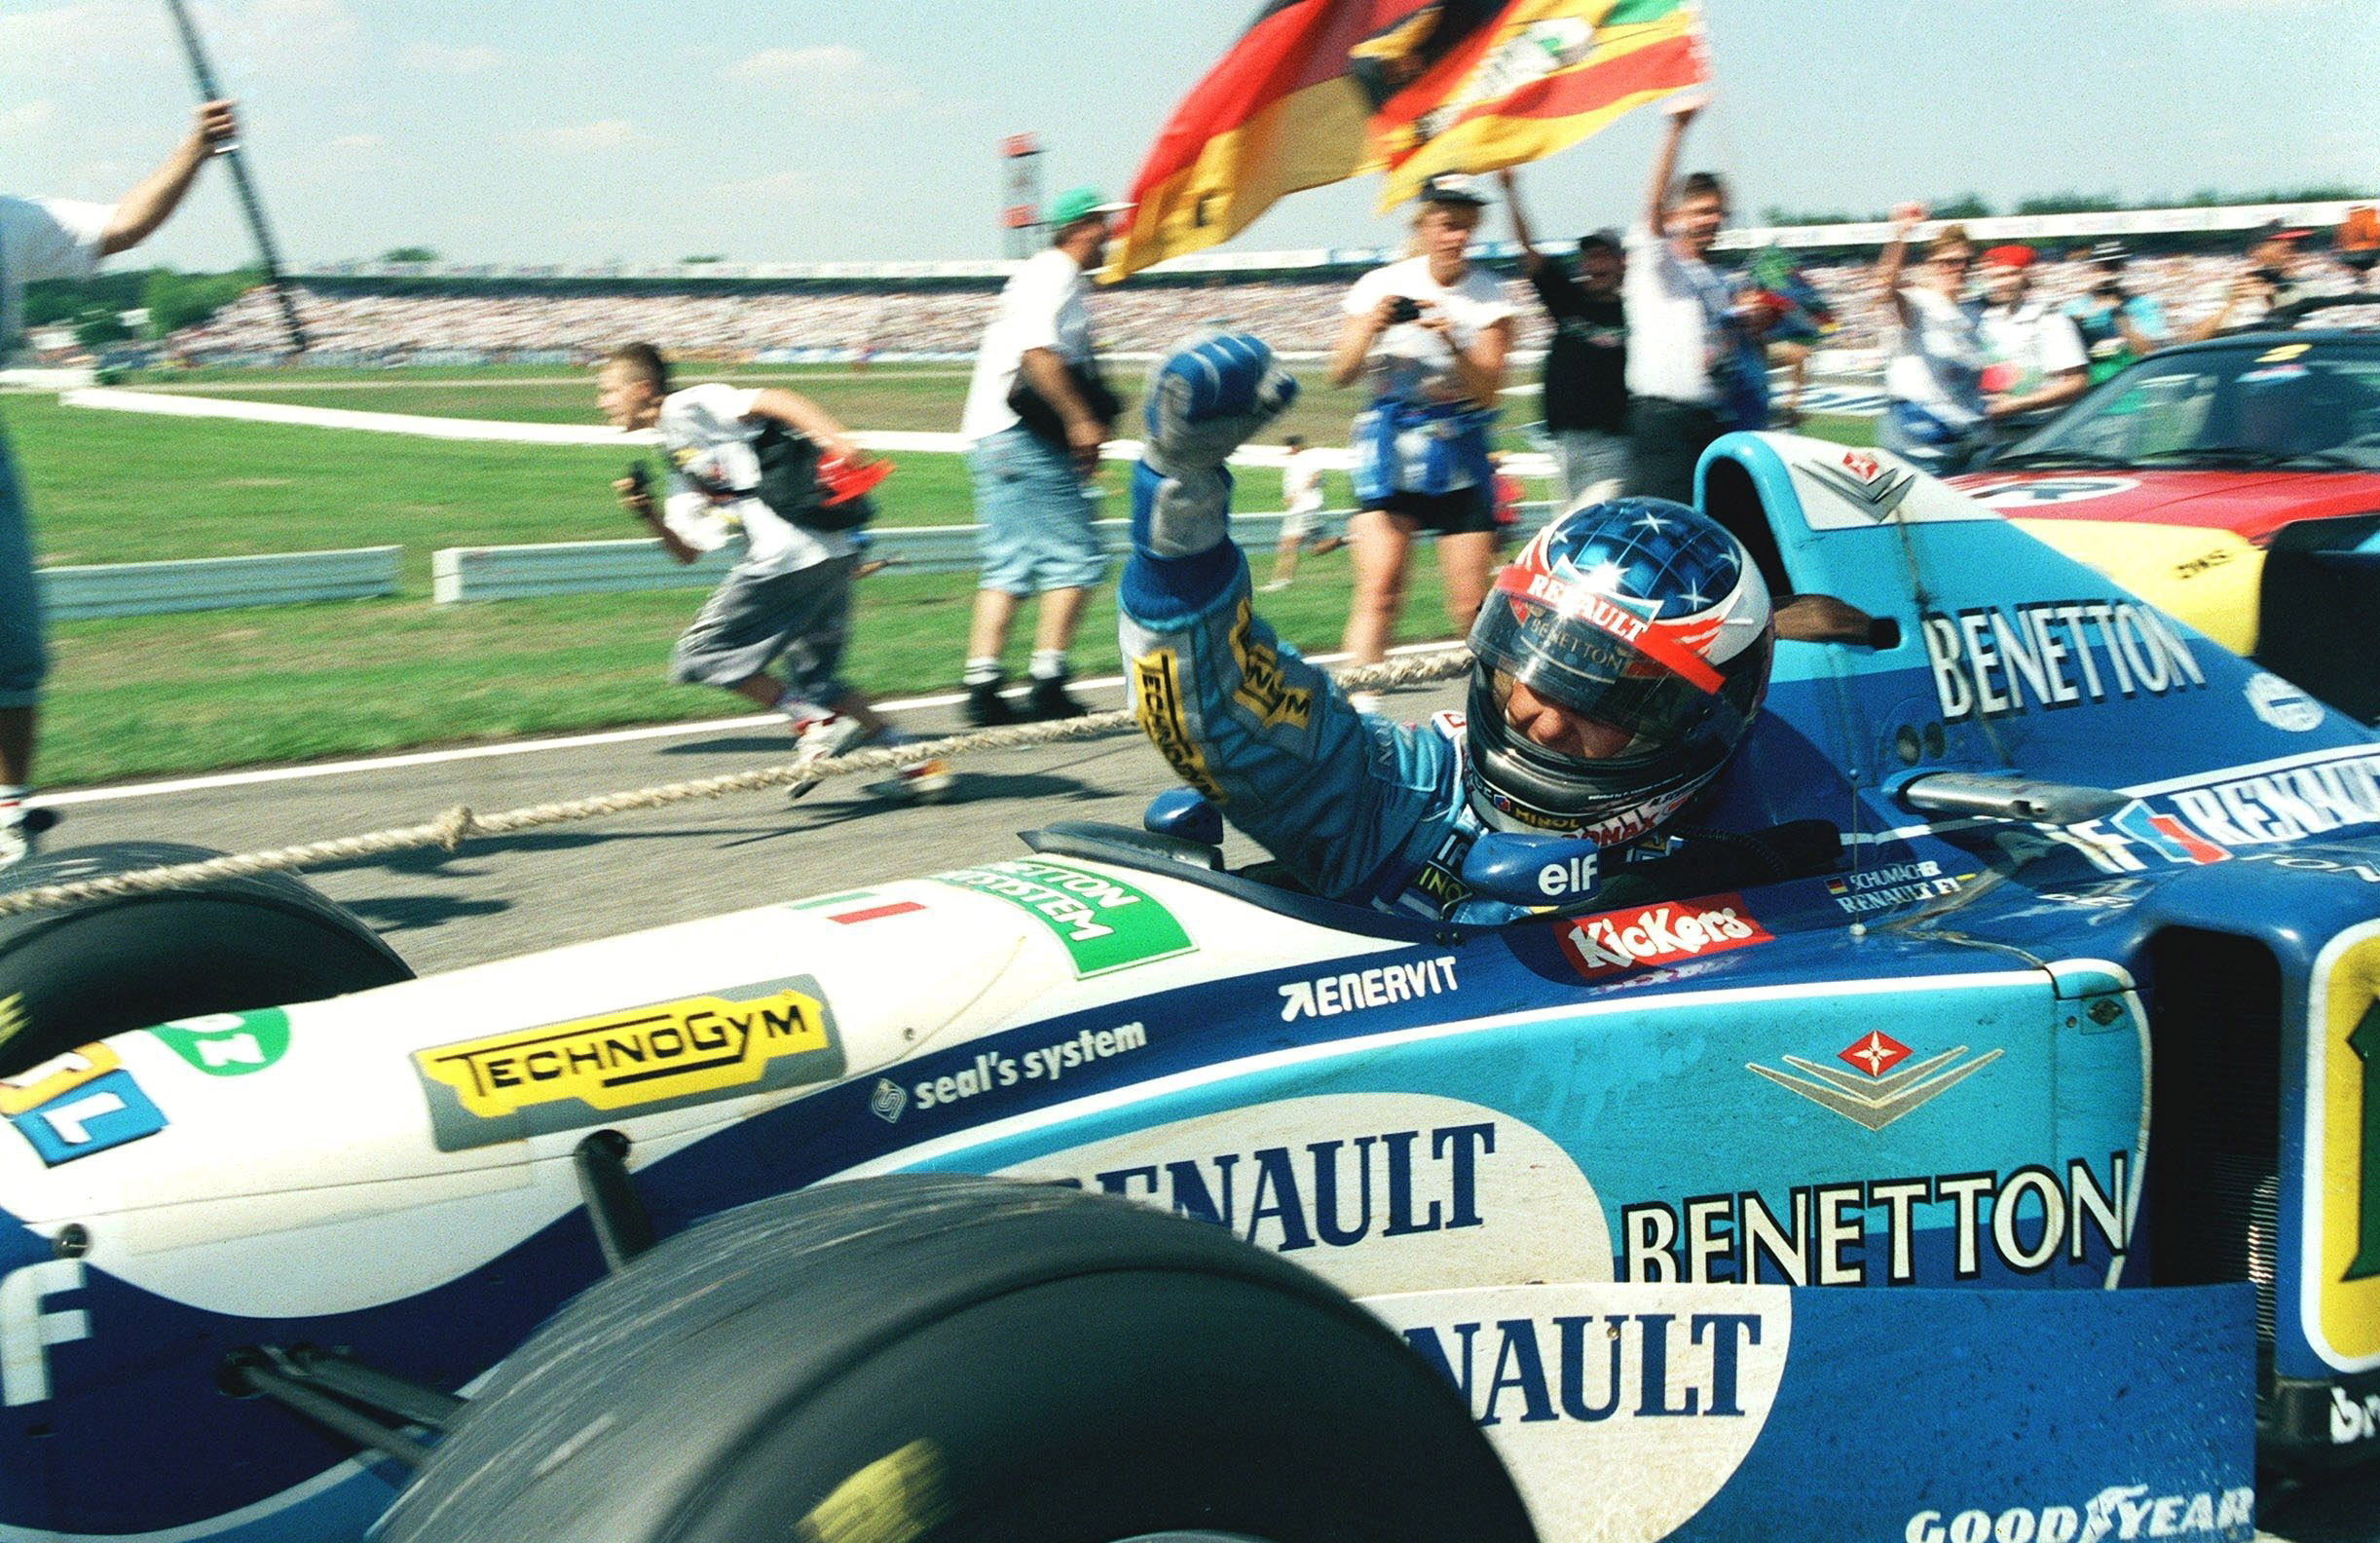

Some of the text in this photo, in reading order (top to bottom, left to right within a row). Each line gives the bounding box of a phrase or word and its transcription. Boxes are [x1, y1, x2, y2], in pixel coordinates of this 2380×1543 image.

[1526, 573, 1649, 644] REAULT
[1921, 598, 2206, 724] BENETTON
[1560, 811, 1658, 847] ONAX
[1538, 853, 1598, 896] elf
[1836, 882, 1936, 914] RENAULT
[915, 1021, 1147, 1110] seal's system
[1620, 1149, 2128, 1286] BENETTON
[1905, 1483, 2255, 1543] GOODYEAR
